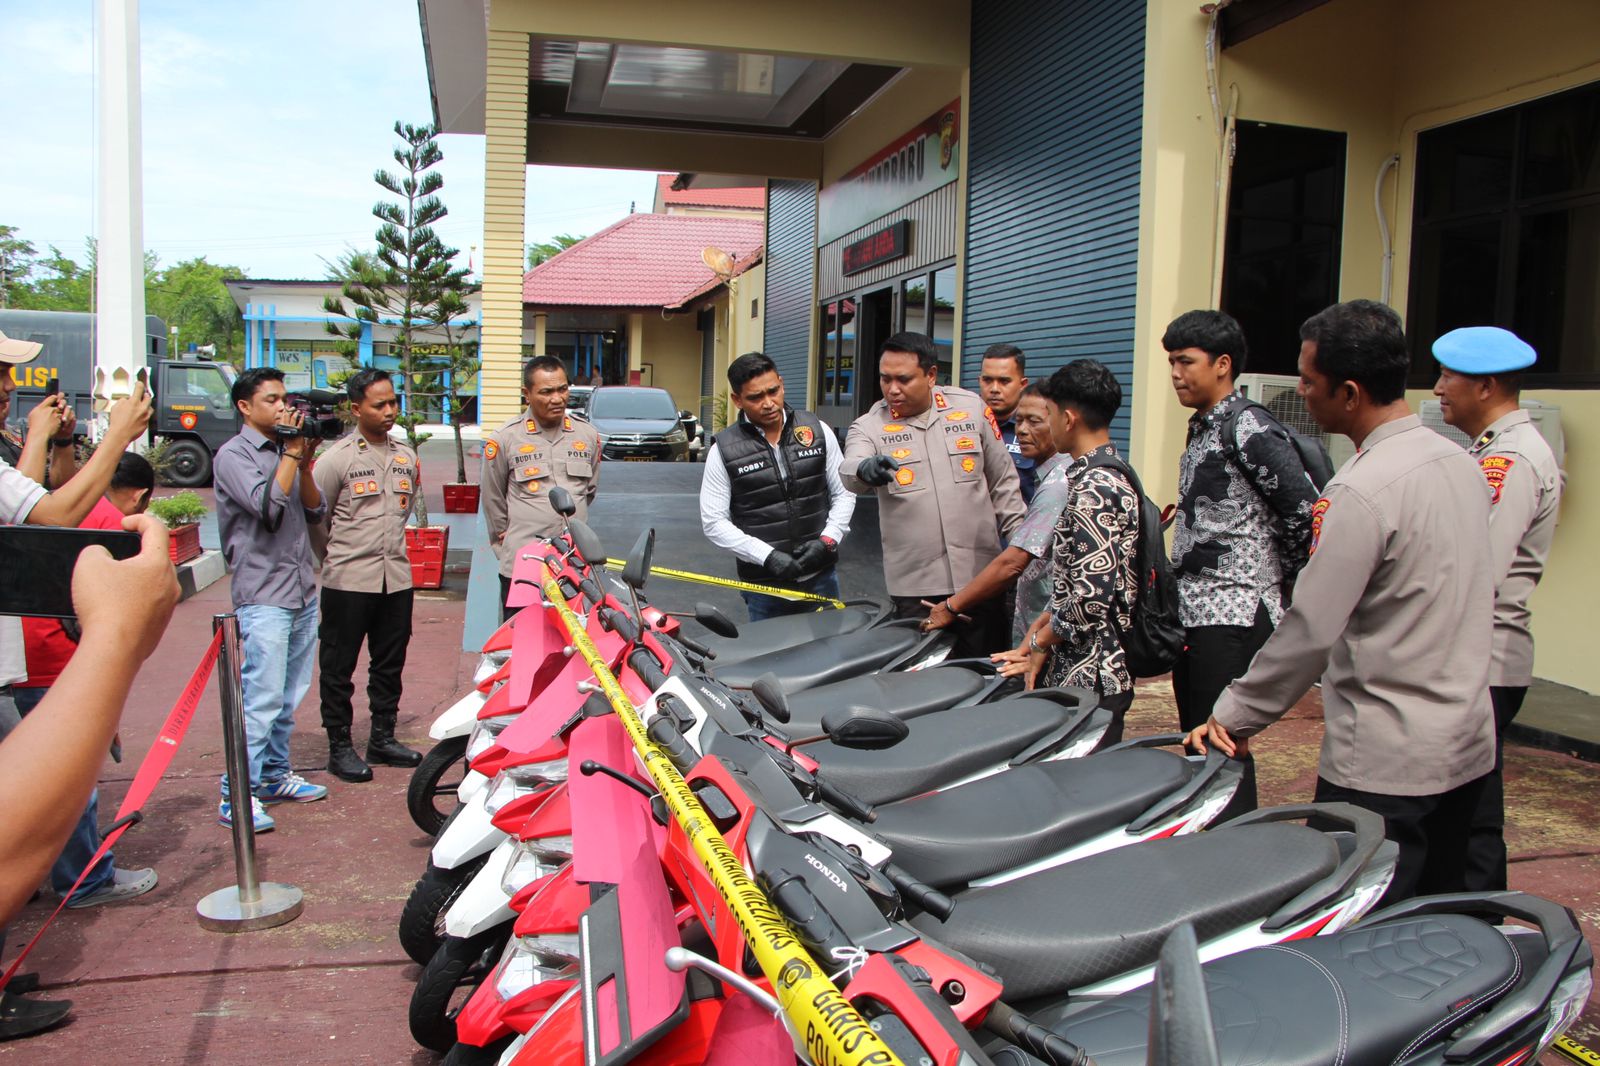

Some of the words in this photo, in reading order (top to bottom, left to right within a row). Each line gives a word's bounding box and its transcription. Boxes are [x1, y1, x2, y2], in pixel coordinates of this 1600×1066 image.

[9, 366, 58, 388] LISI
[944, 423, 976, 434] POLRI
[881, 433, 913, 444] YHOGI
[514, 454, 531, 463] BUDI
[798, 447, 823, 457] KASAT
[392, 467, 413, 476] POLRI
[738, 461, 765, 474] ROBBY
[700, 686, 726, 710] HONDA
[707, 837, 751, 887] DILARANG
[804, 853, 848, 893] HONDA
[813, 989, 878, 1054] GARIS
